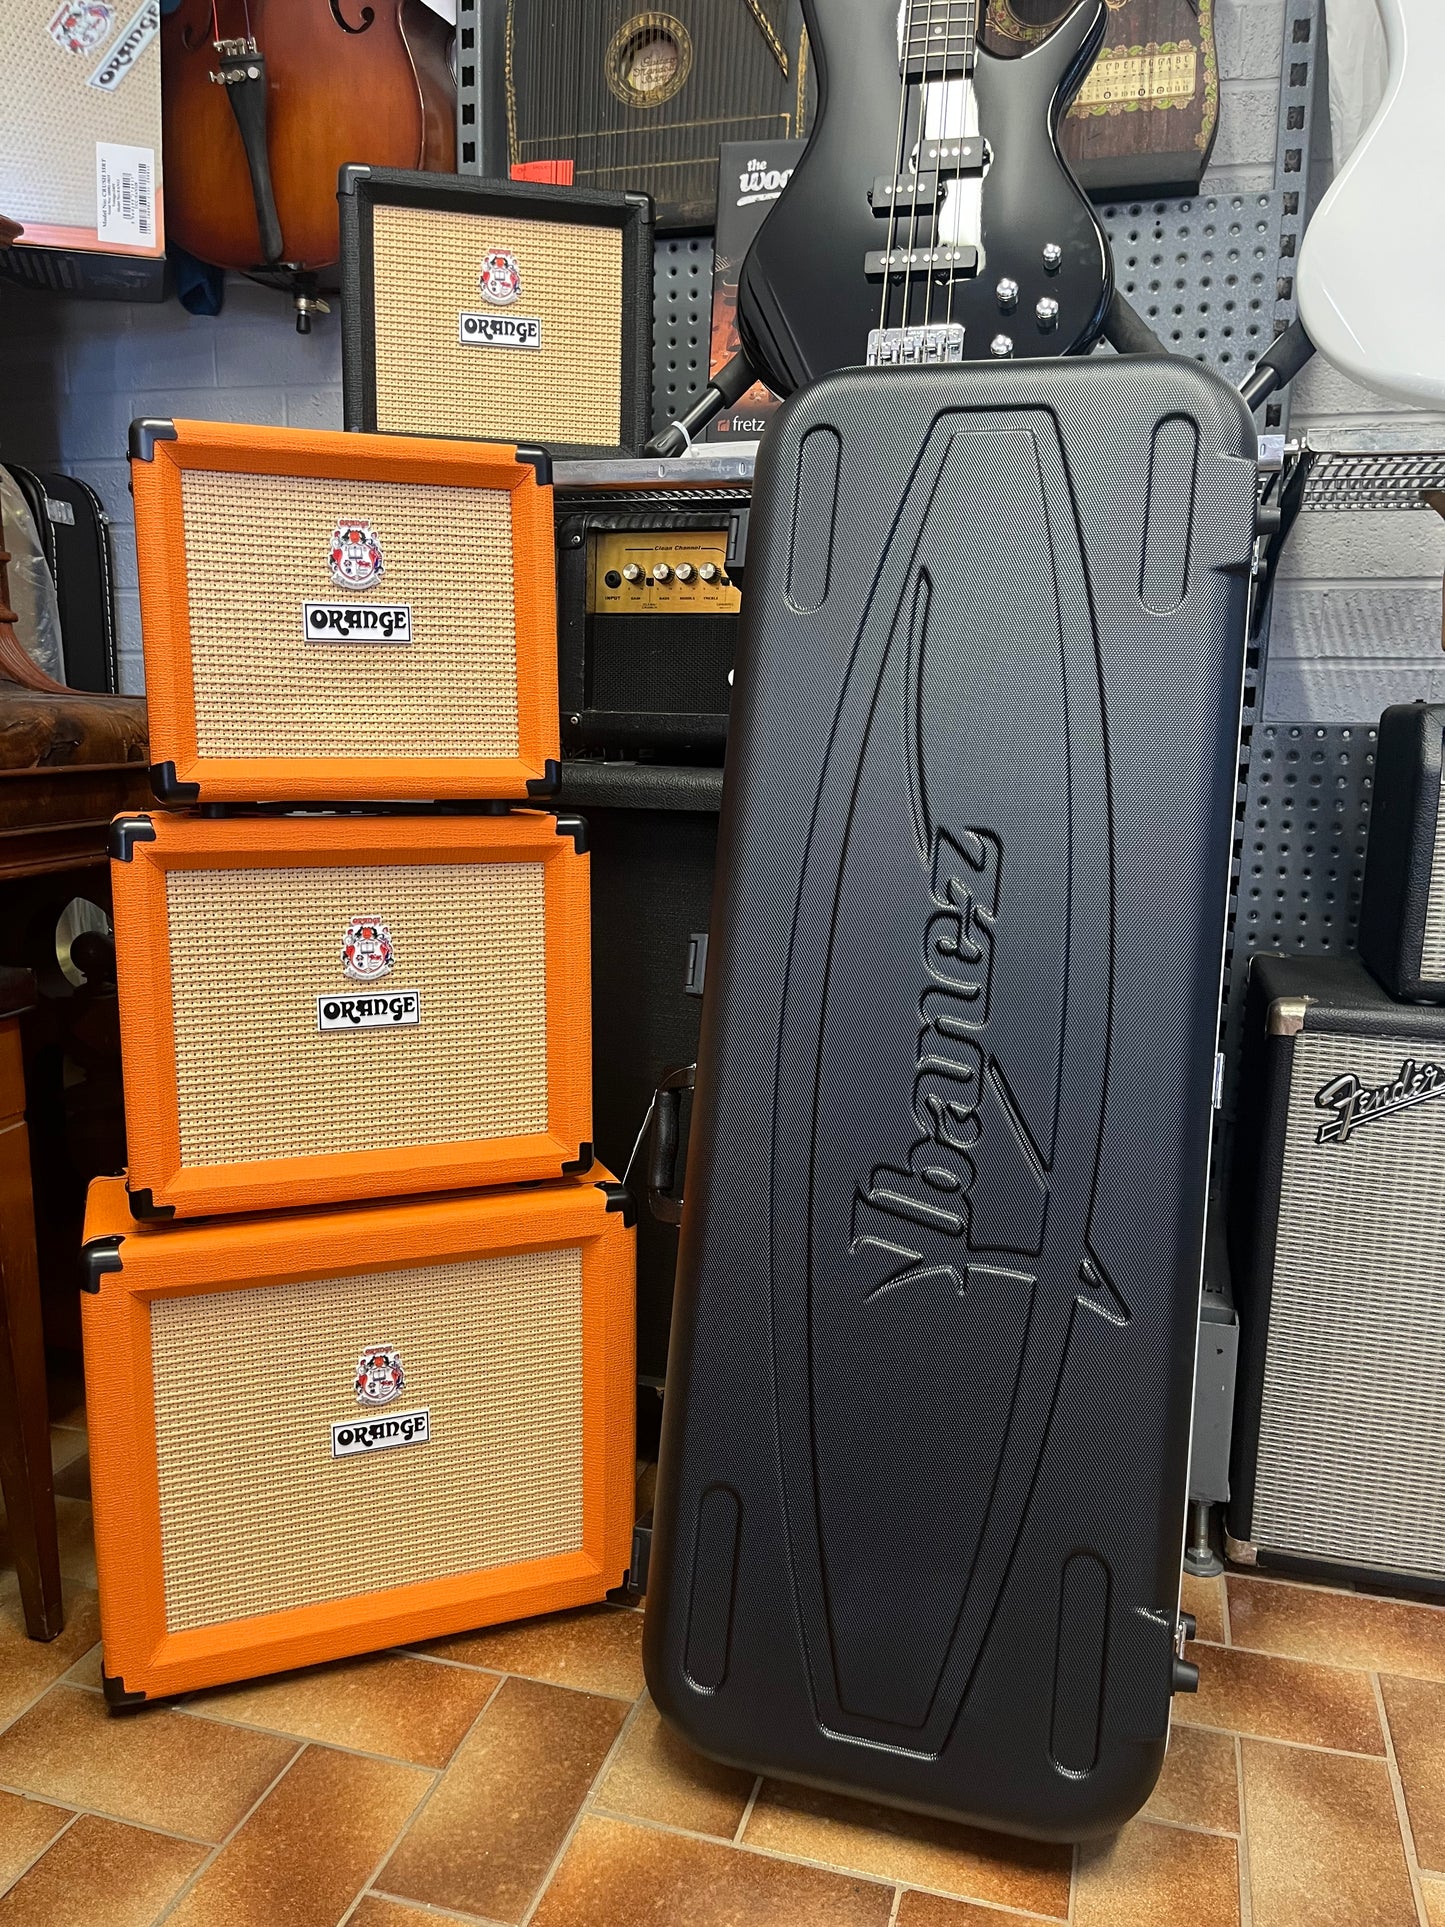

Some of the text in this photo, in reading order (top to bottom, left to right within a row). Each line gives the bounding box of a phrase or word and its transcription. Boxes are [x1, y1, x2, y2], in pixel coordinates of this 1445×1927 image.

[99, 4, 159, 84] ORANGE
[747, 158, 768, 172] the
[464, 318, 537, 343] ORANGE
[732, 415, 766, 432] fretz
[310, 609, 407, 637] ORANGE
[323, 996, 416, 1024] ORANGE
[849, 827, 1003, 1302] Ibanez
[1315, 1059, 1445, 1143] Fender
[337, 1416, 426, 1447] ORANGE
